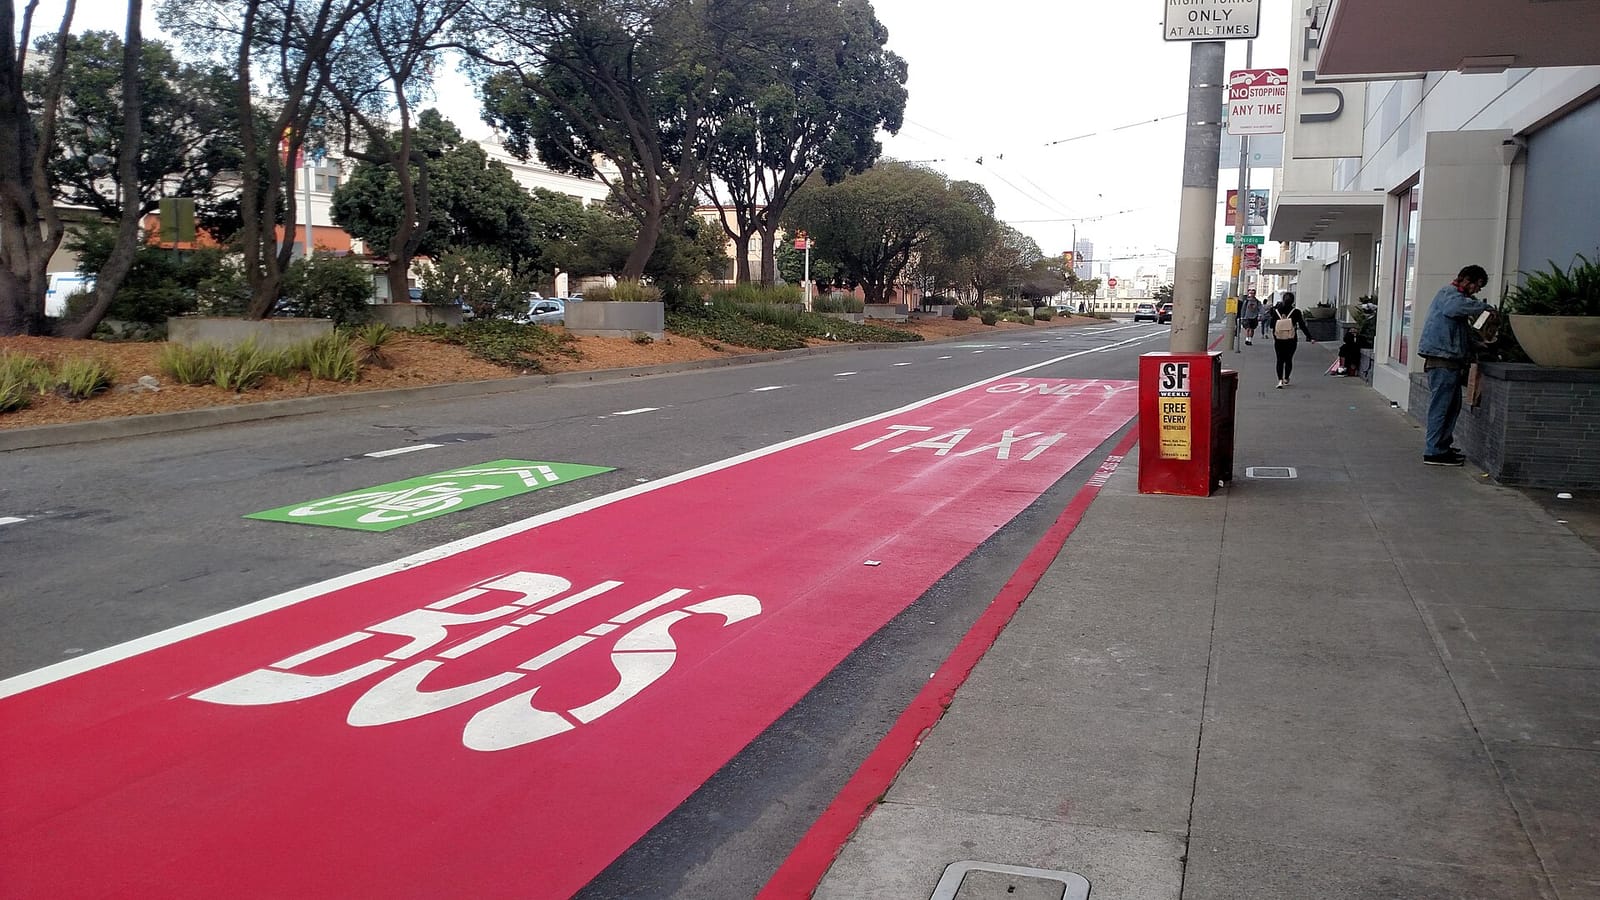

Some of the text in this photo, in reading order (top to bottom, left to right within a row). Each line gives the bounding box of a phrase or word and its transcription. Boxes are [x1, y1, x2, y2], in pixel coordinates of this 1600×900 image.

[1188, 9, 1232, 22] ONLY
[1170, 25, 1250, 36] AT ALL TIMES
[1231, 87, 1285, 98] NO STOPPING
[1232, 104, 1282, 116] ANY TIME
[1162, 363, 1189, 389] SF
[986, 382, 1139, 398] ONLY
[1163, 403, 1186, 413] FREE
[1163, 415, 1187, 424] EVERY
[851, 424, 1068, 461] TAXI
[189, 571, 763, 752] BUS
